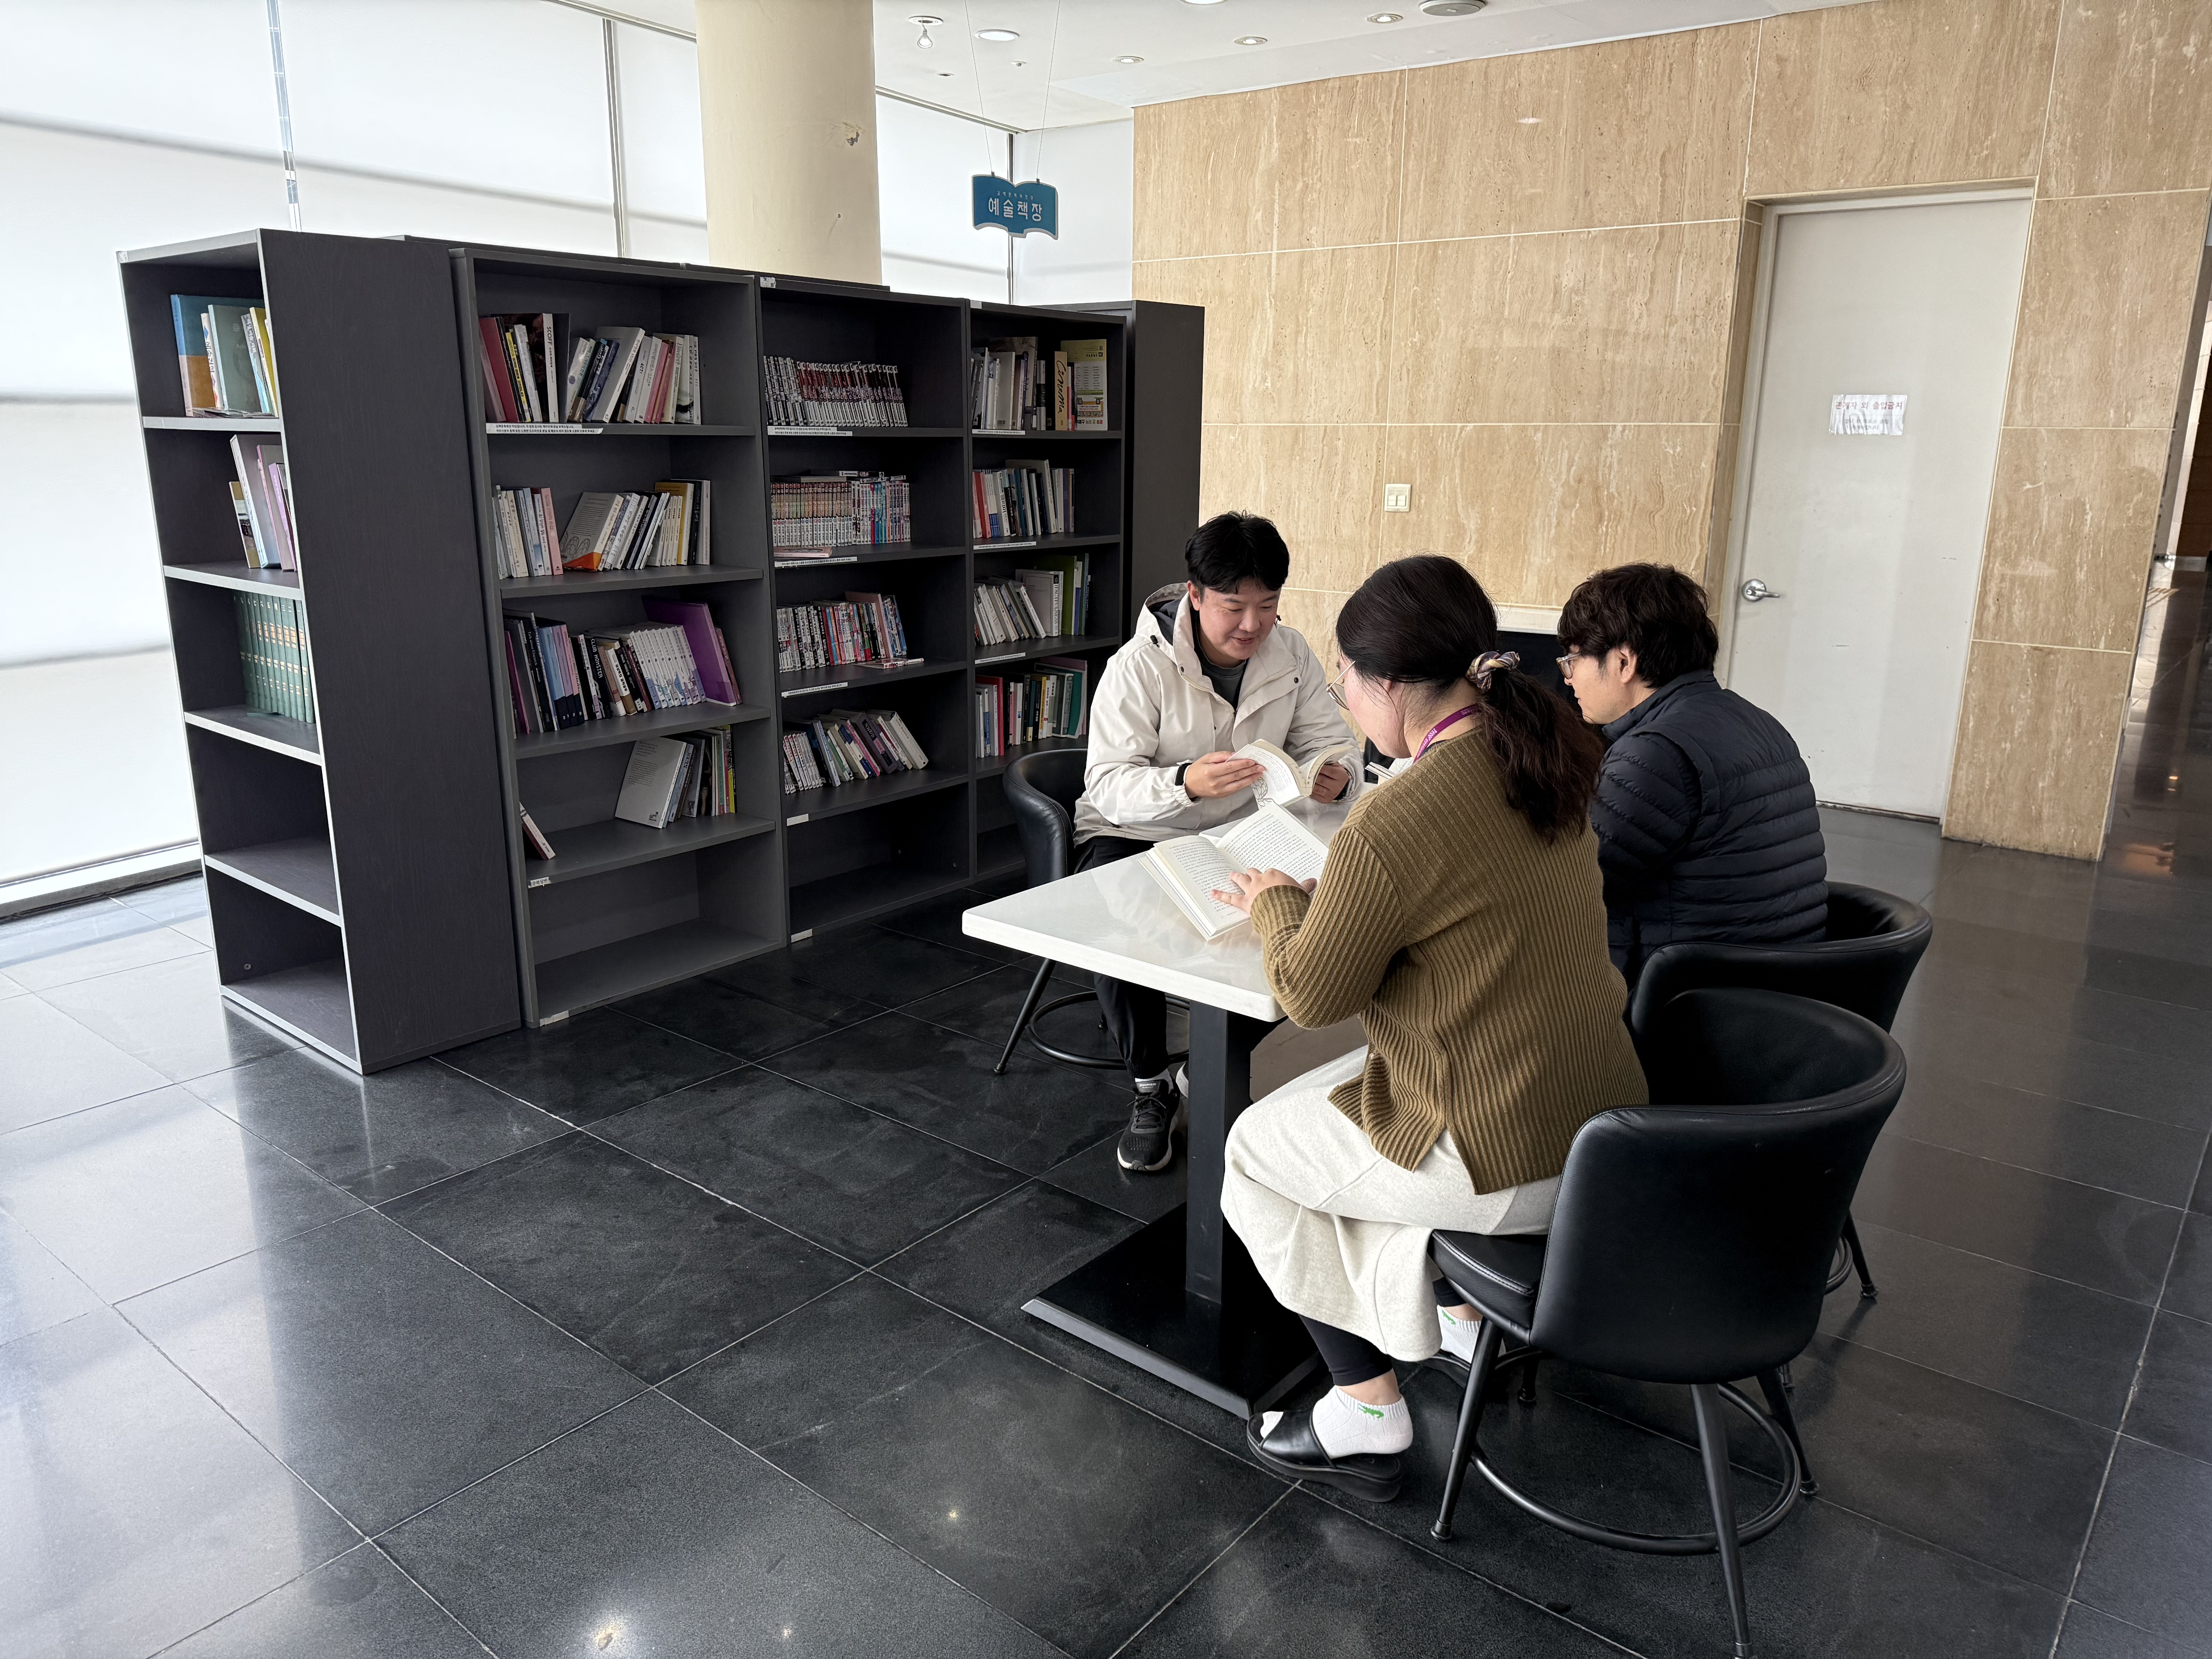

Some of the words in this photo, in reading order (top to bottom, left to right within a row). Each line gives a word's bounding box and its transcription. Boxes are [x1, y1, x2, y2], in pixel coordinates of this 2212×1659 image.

[988, 198, 1042, 222] 예술책장
[1873, 402, 1903, 410] 출입금지
[594, 654, 603, 678] MONSTER
